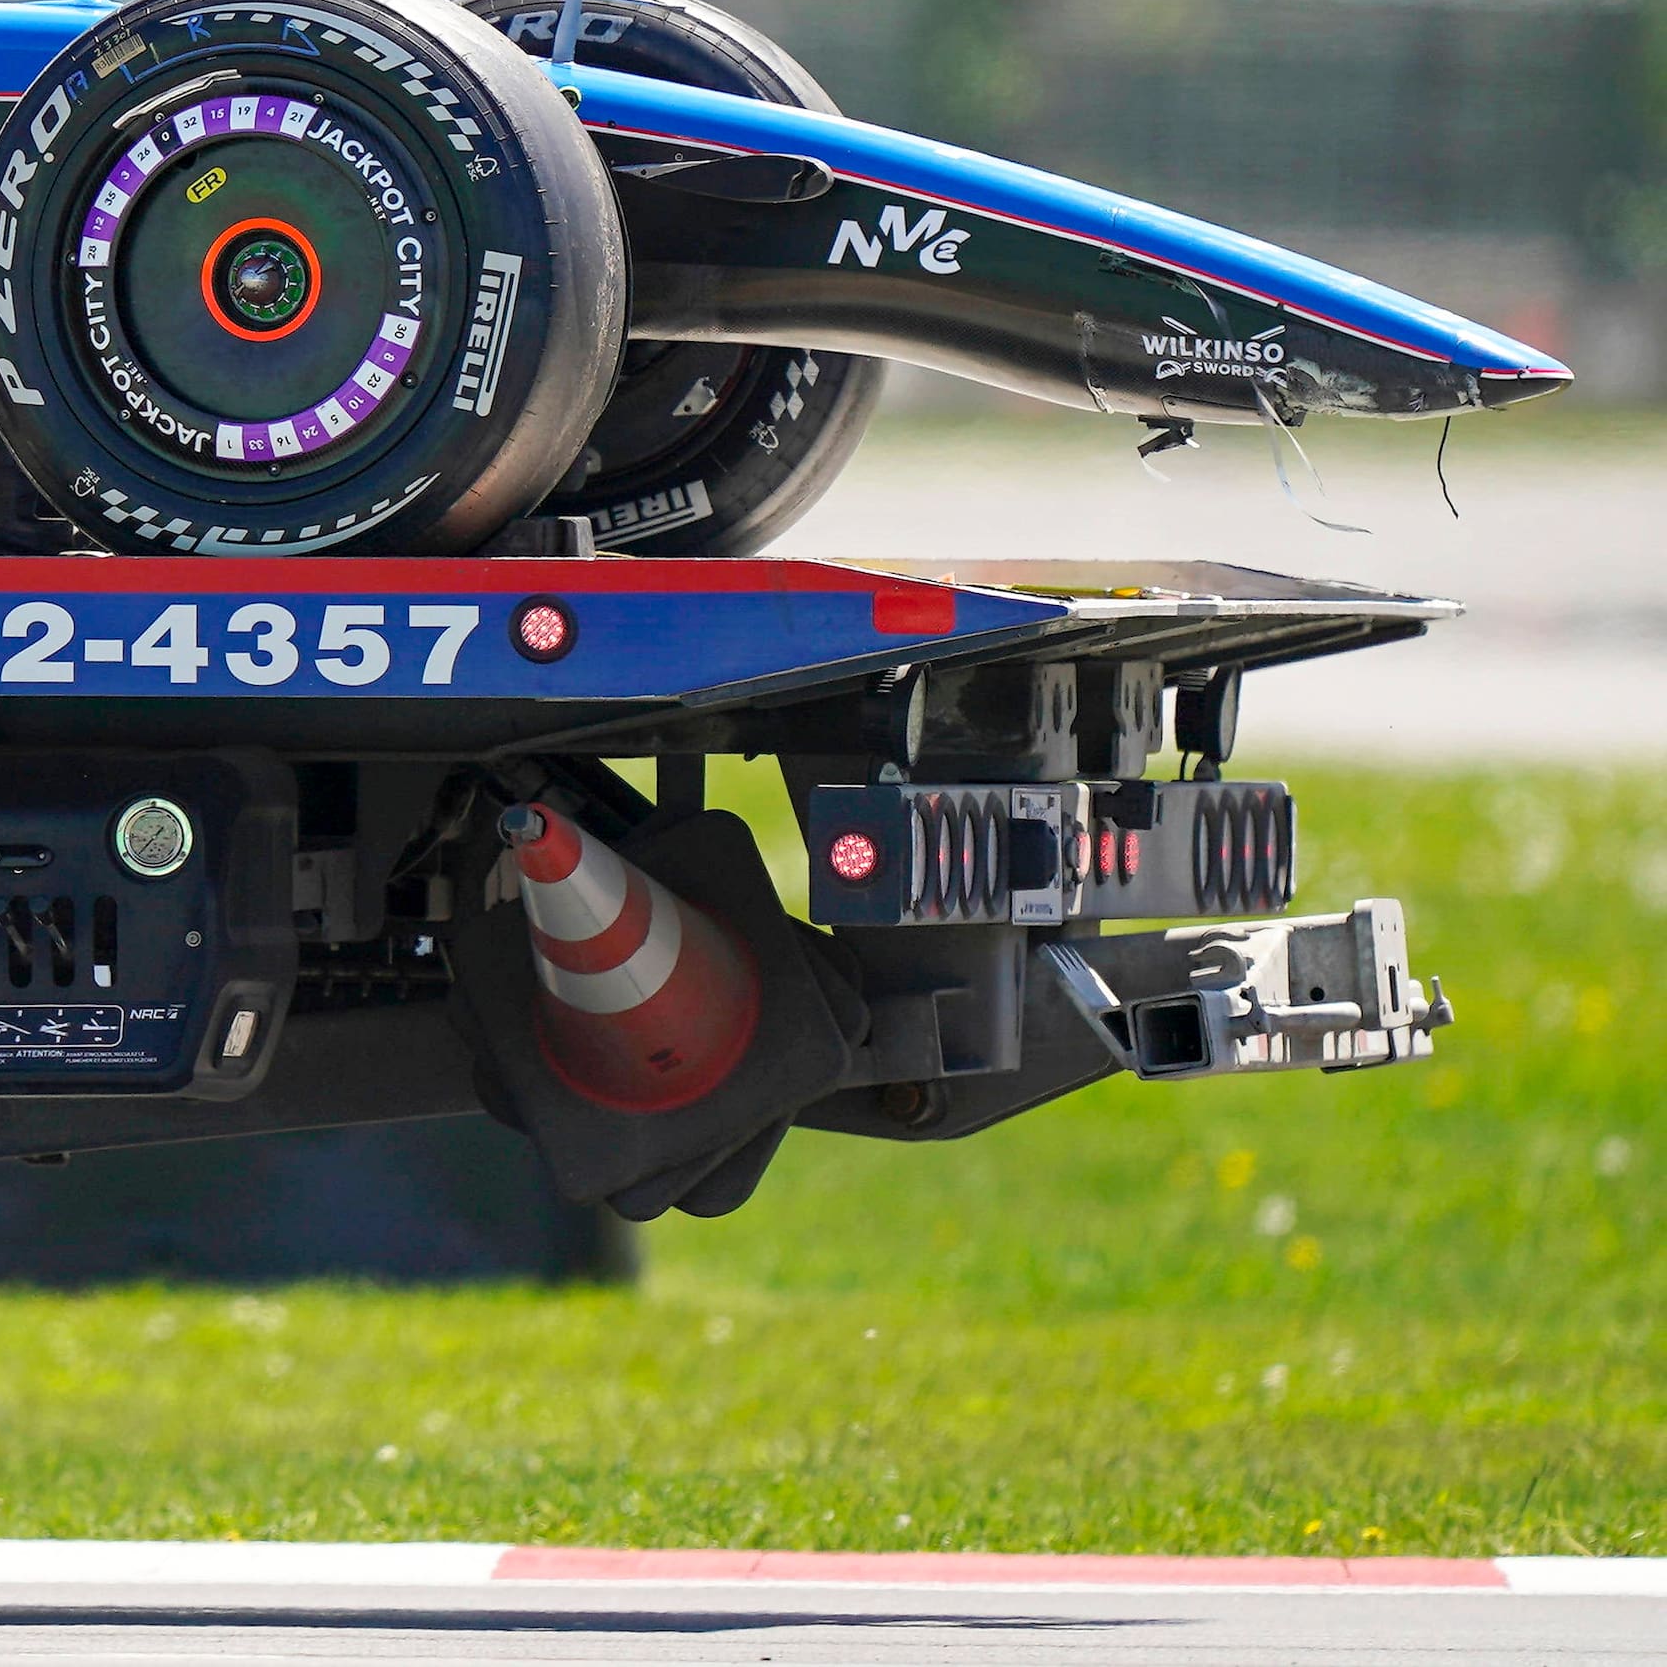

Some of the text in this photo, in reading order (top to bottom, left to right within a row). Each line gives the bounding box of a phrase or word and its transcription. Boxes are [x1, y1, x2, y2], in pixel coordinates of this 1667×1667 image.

[507, 10, 634, 44] RO
[210, 108, 225, 120] 15
[237, 106, 251, 116] 19
[266, 107, 276, 117] 4
[289, 111, 304, 123] 21
[182, 116, 197, 129] 32
[137, 147, 151, 162] 26
[121, 171, 130, 181] 3
[191, 172, 223, 200] FR
[105, 191, 117, 206] 35
[366, 195, 386, 221] .NET
[92, 216, 105, 231] 12
[307, 118, 423, 318] JACKPOT CITY
[87, 245, 97, 260] 28
[394, 323, 407, 339] 30
[452, 249, 523, 417] PIRELLI
[1142, 335, 1284, 363] WILKINSO
[85, 272, 213, 453] JACKPOT CITY
[383, 352, 395, 362] 8
[124, 360, 148, 385] .NET
[1193, 361, 1254, 377] SWORD
[367, 372, 381, 388] 23
[348, 395, 365, 410] 10
[331, 413, 339, 425] 5
[302, 425, 318, 438] 24
[248, 440, 264, 451] 33
[277, 436, 291, 445] 16
[588, 480, 714, 549] PIREL
[129, 1009, 165, 1020] NRC
[15, 1049, 65, 1057] ATTENTION:
